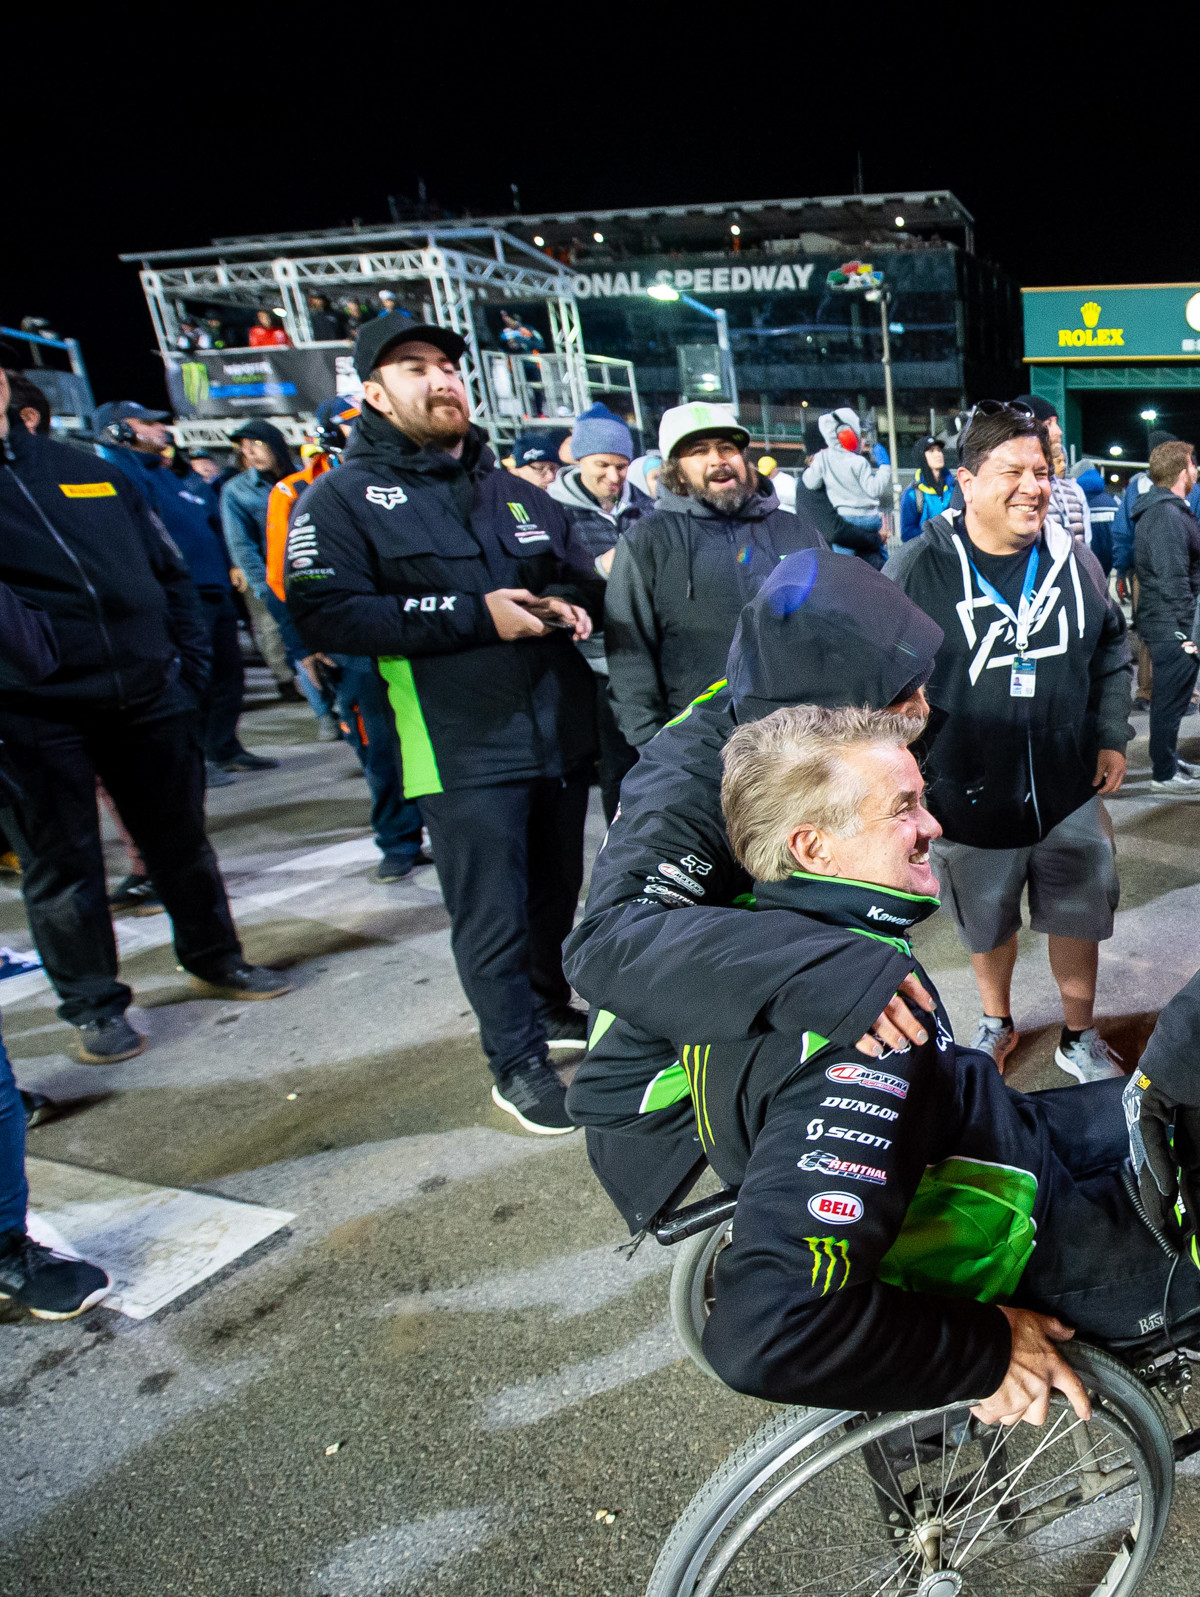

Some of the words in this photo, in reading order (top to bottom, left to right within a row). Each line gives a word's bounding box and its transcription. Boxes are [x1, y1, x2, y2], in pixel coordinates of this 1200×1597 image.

[573, 271, 648, 298] ONAL
[655, 263, 815, 295] SPEEDWAY
[1058, 328, 1124, 347] ROLEX
[404, 597, 456, 612] FOX
[866, 905, 912, 926] Kawas
[820, 1096, 899, 1122] DUNLOP
[825, 1126, 893, 1150] SCOTT
[828, 1159, 888, 1180] RENTHAL
[818, 1198, 857, 1218] BELL
